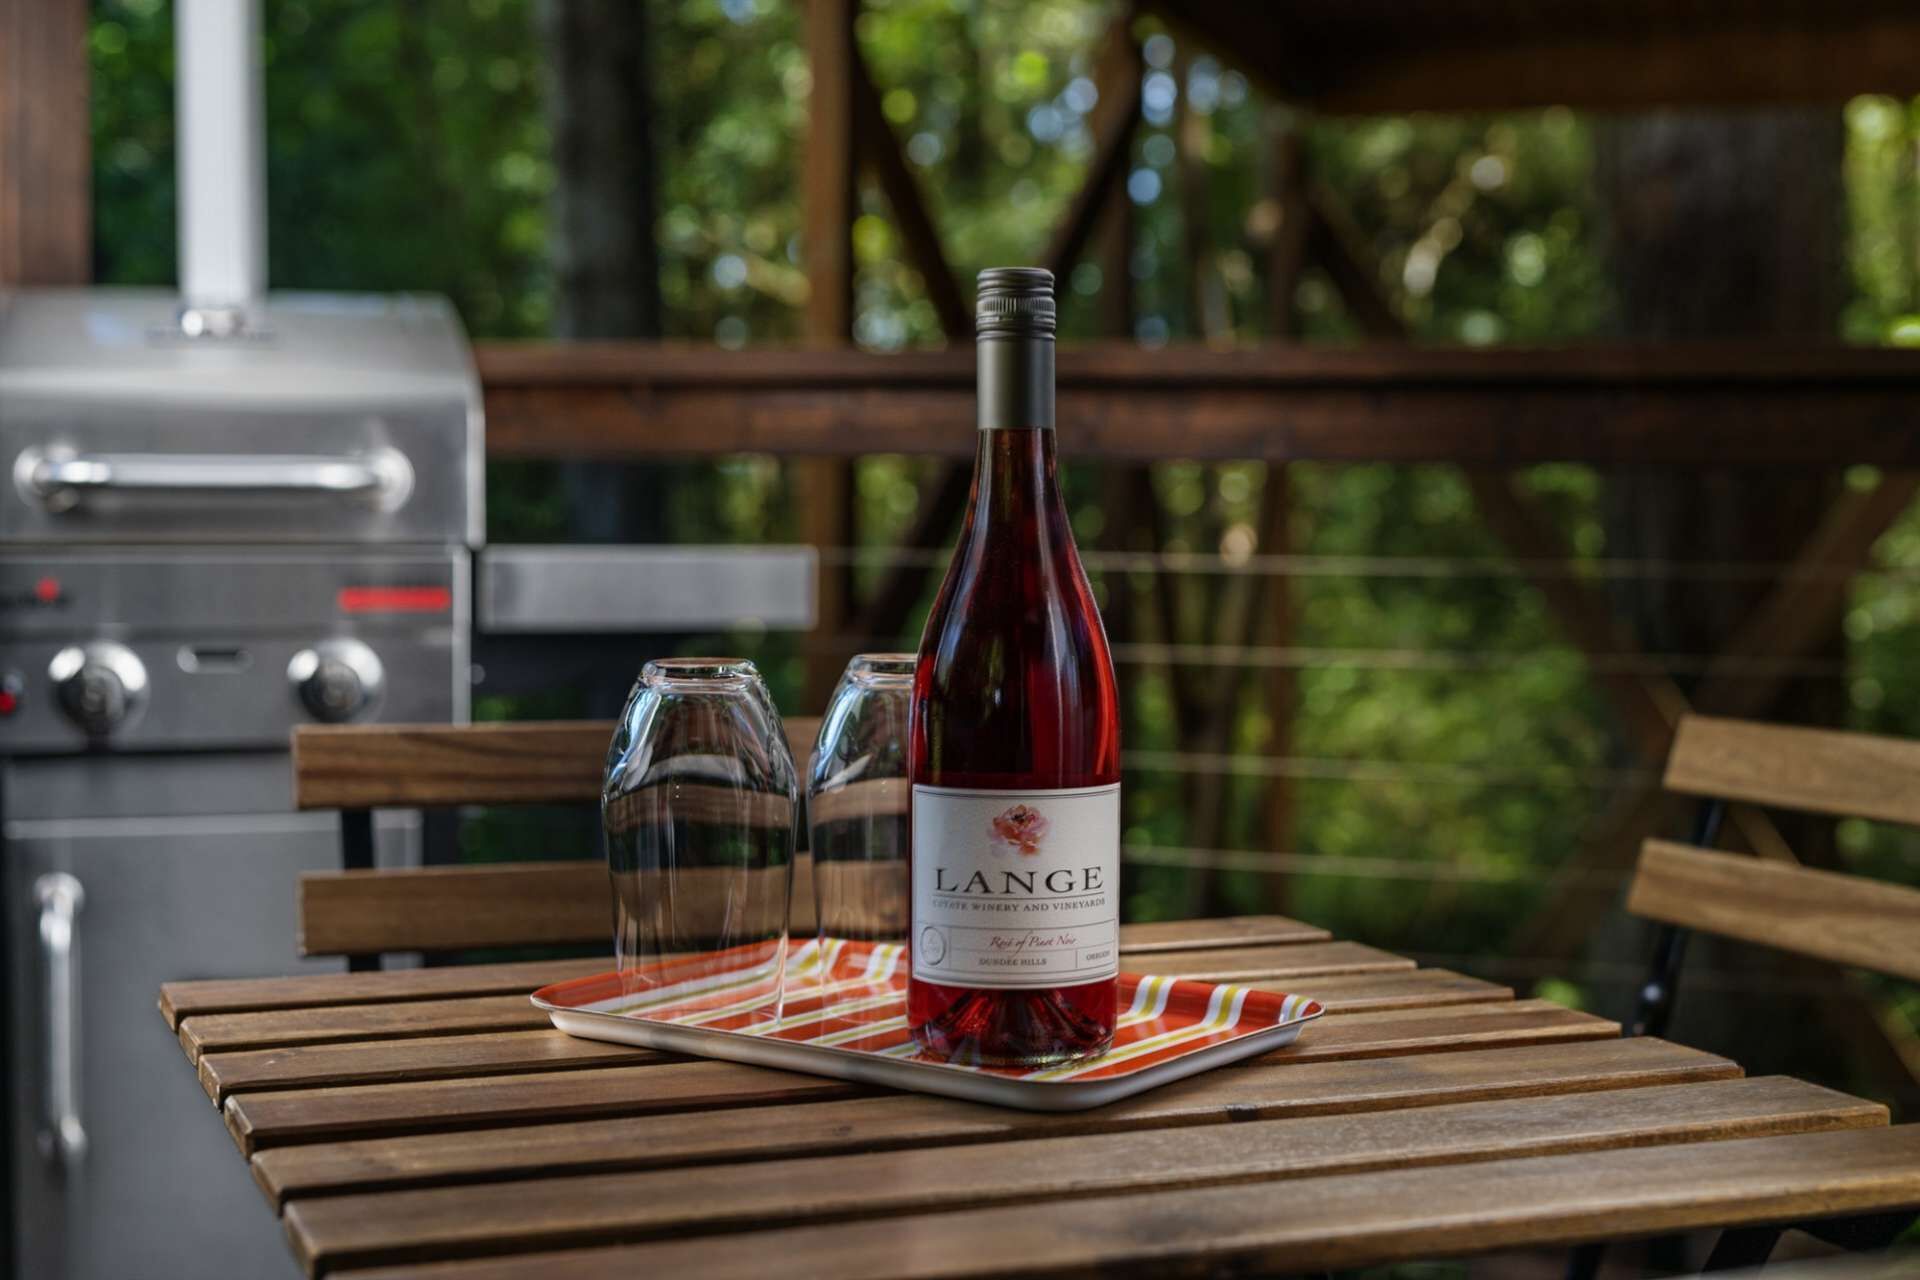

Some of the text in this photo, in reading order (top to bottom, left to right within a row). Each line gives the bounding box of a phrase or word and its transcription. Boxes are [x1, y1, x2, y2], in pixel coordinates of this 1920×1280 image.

[935, 866, 1104, 895] LANGE
[972, 904, 1019, 912] WINERY
[1023, 903, 1049, 912] AND
[1052, 898, 1106, 911] VINEYARDS
[1020, 957, 1047, 966] HILLS
